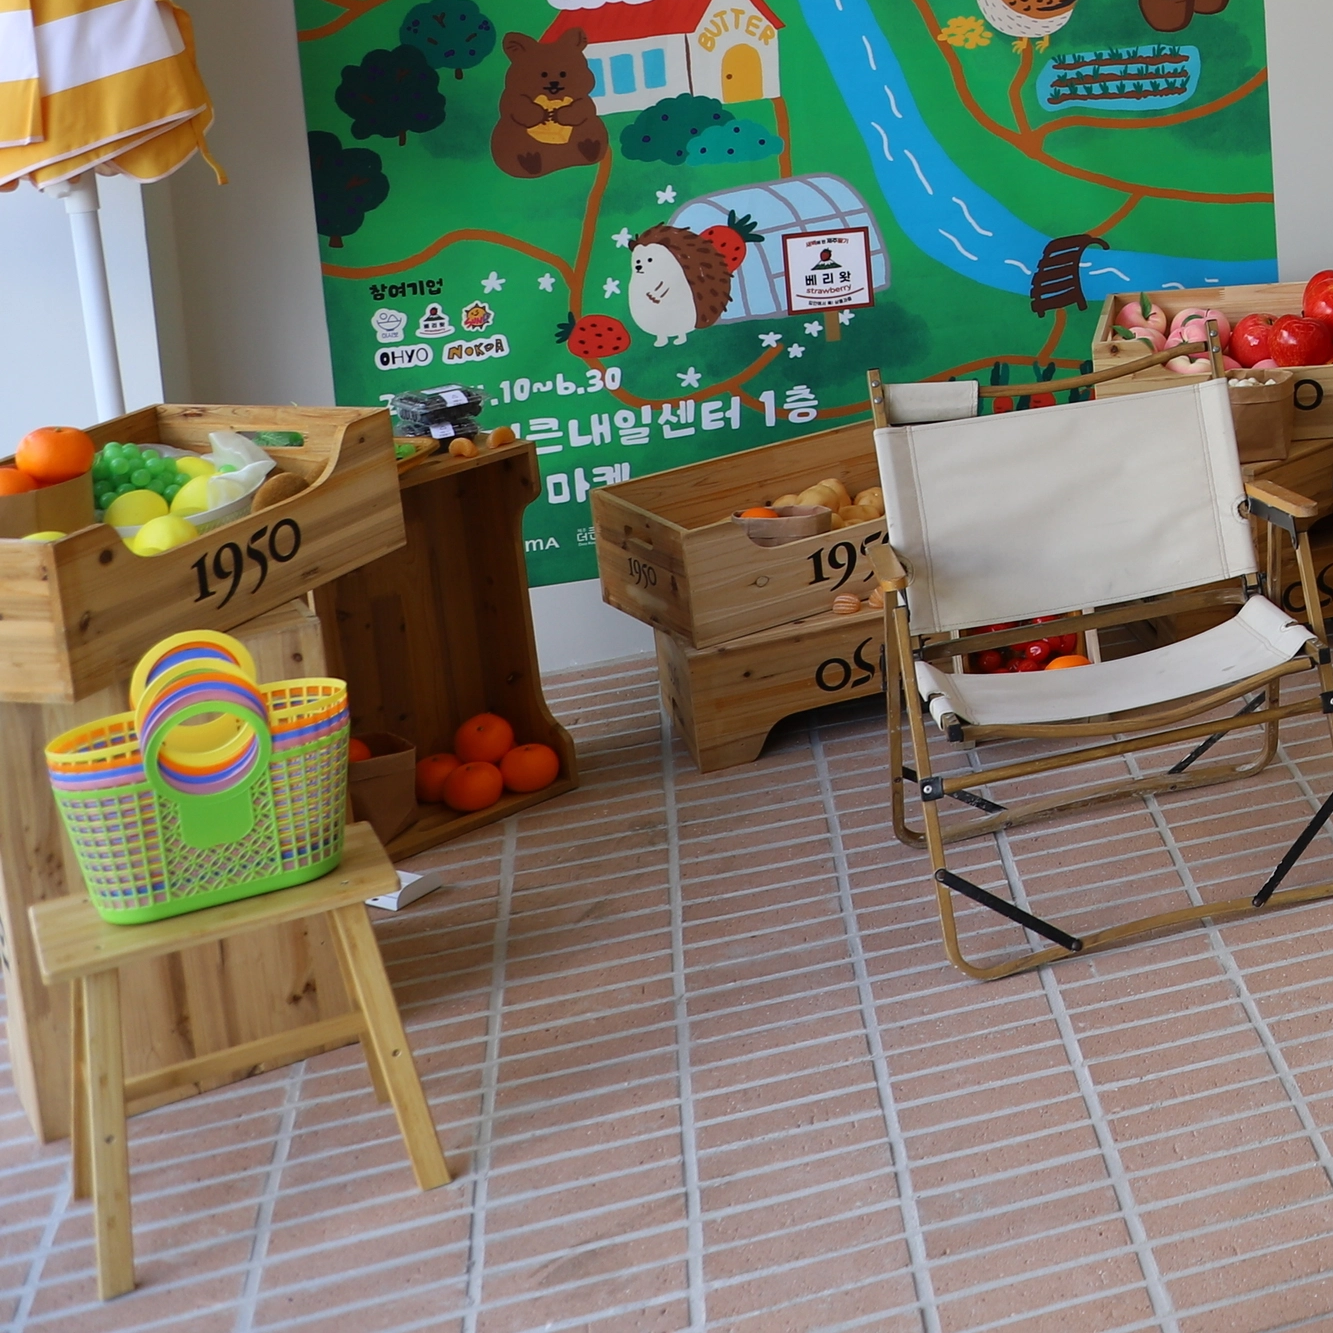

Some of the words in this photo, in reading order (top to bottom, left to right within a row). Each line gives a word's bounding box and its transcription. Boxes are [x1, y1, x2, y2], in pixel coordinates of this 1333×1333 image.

[697, 7, 776, 52] BUTTER
[369, 278, 443, 301] 참여기업
[806, 284, 851, 294] strawberry
[380, 348, 428, 366] OHYO
[447, 339, 504, 360] NOKDA
[758, 384, 819, 428] 1층
[190, 518, 301, 609] 1950
[628, 556, 657, 589] 1950
